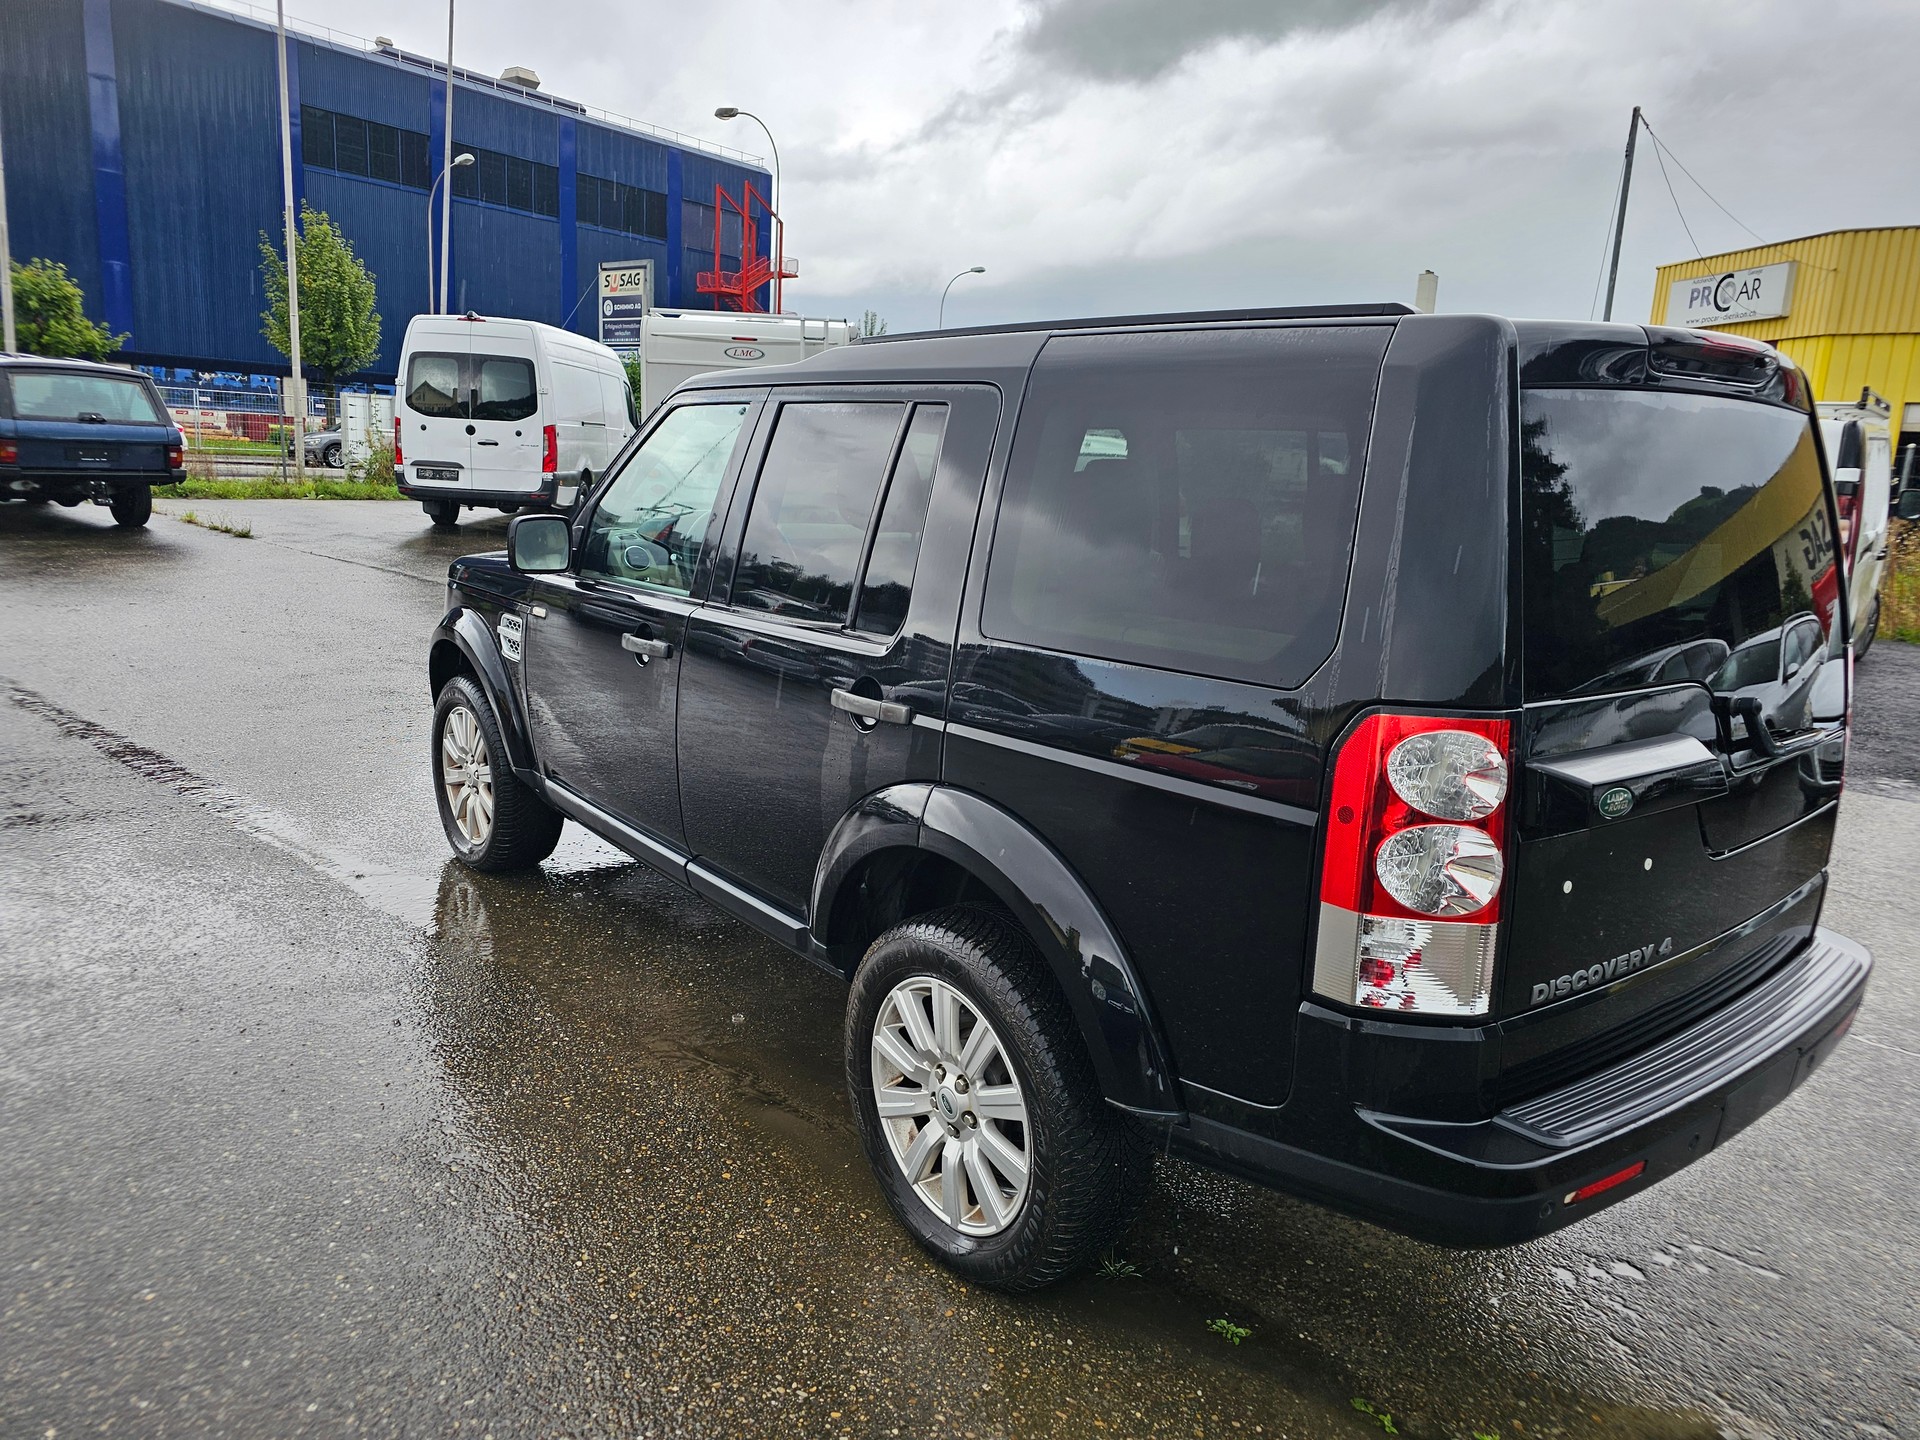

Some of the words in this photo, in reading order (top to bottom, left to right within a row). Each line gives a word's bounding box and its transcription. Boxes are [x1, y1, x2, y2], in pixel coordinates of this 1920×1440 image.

[604, 272, 641, 293] SUSAG
[734, 349, 756, 357] LMC
[1607, 792, 1624, 804] LAND
[1608, 800, 1629, 812] ROVER
[1530, 943, 1655, 1006] DISCOVERY
[1656, 937, 1673, 956] 4
